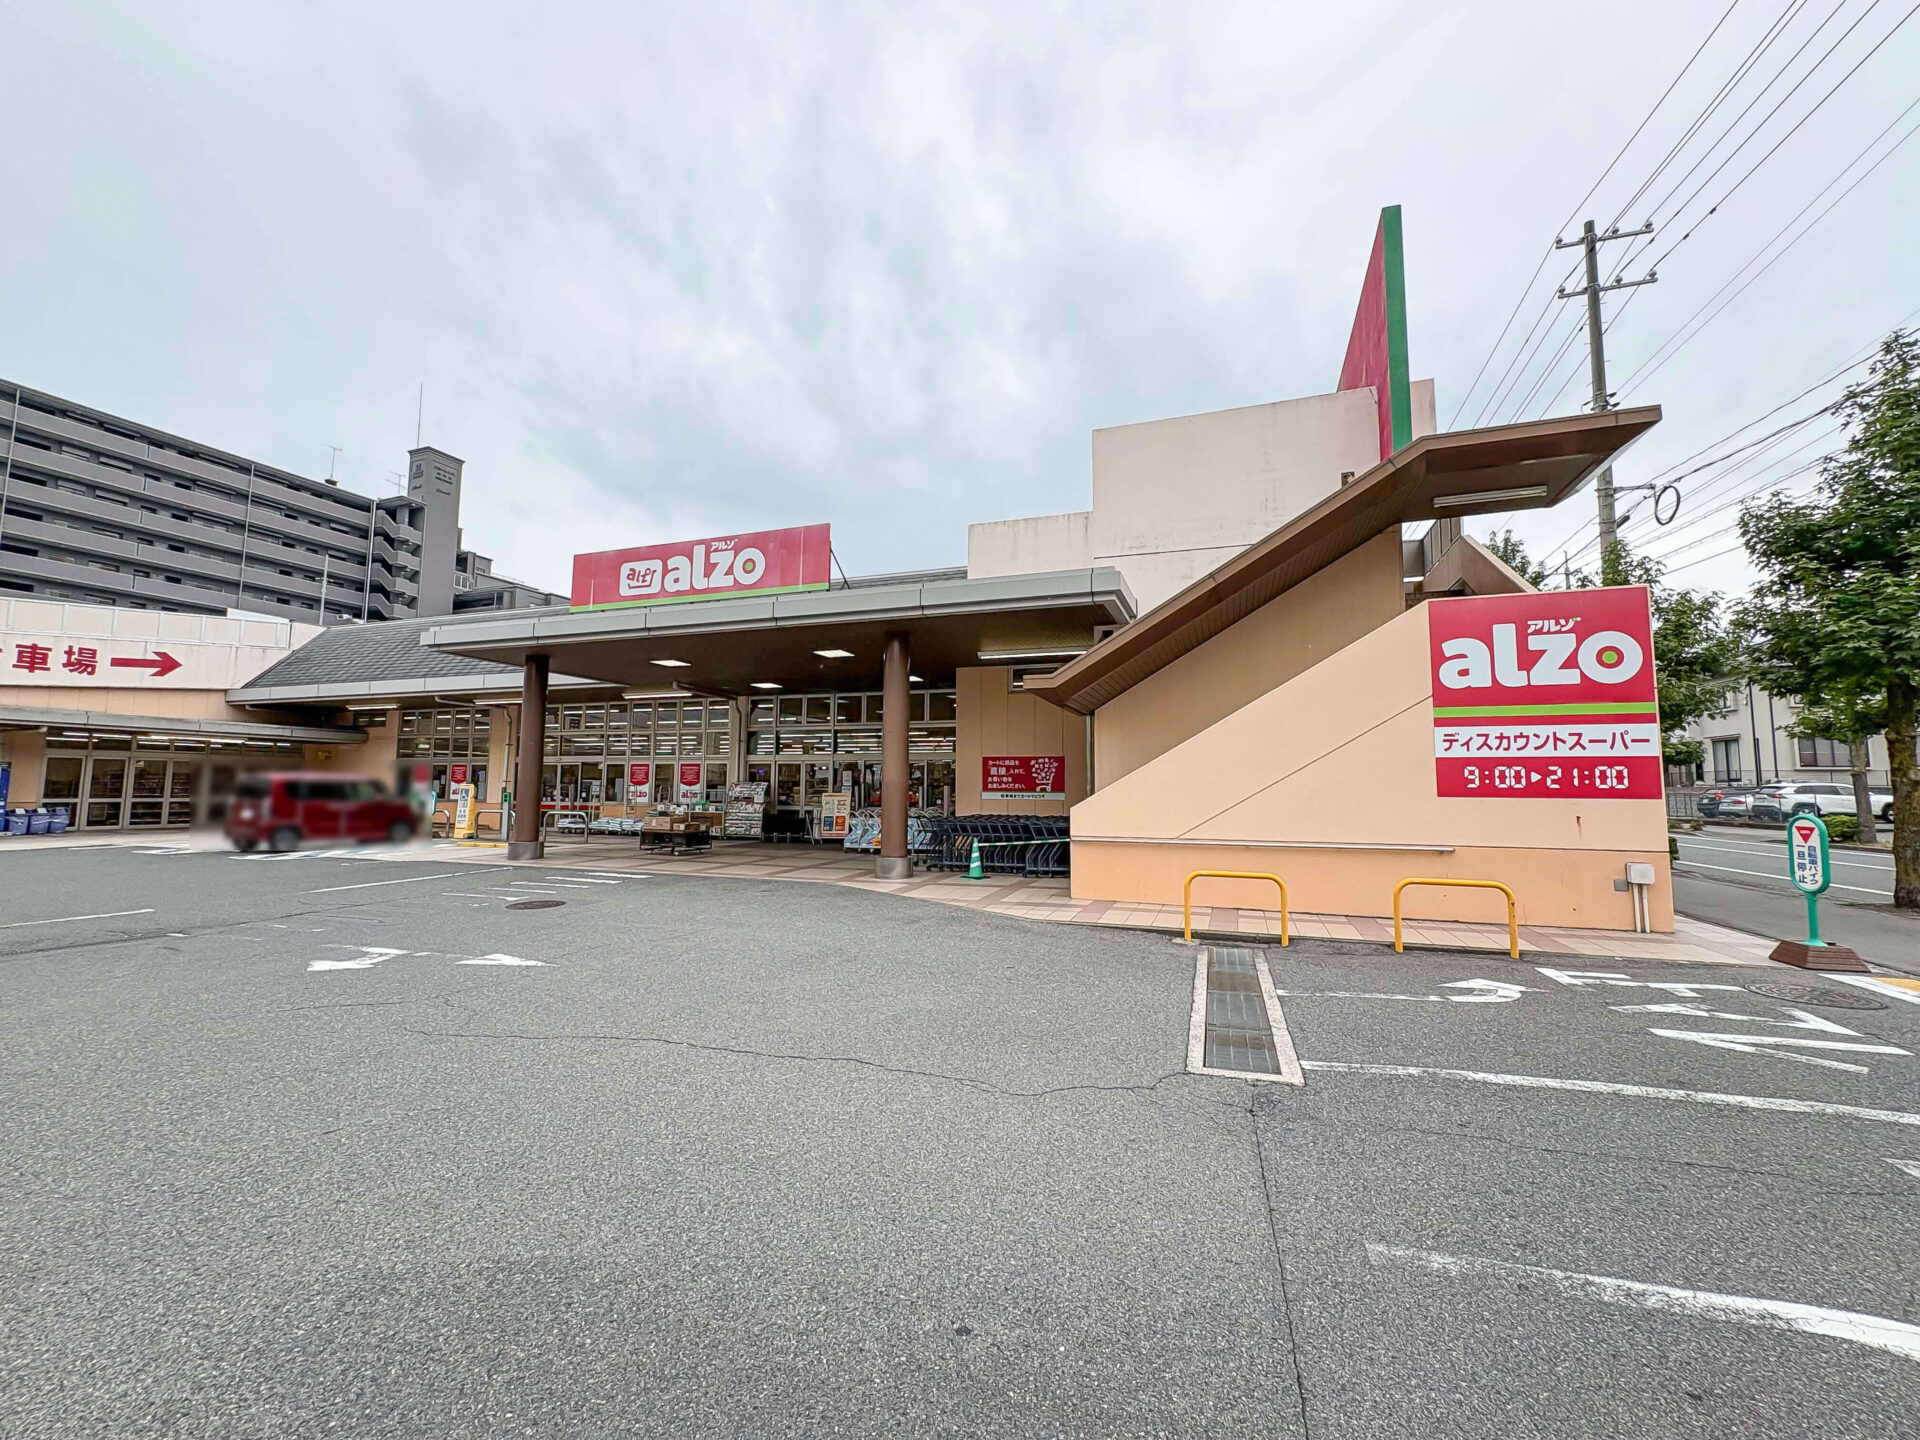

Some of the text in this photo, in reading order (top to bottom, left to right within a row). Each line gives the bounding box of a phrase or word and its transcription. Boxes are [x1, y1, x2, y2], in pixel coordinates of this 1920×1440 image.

[710, 538, 738, 551] アルゾ
[664, 545, 766, 592] alzo
[1527, 617, 1582, 634] アルゾ
[0, 643, 99, 676] 車場
[1438, 622, 1643, 690] alzo
[1442, 731, 1650, 753] ディスカウントスーパー
[1464, 765, 1629, 789] 9:00 21:00
[1795, 844, 1808, 884] 一旦停止
[1807, 845, 1819, 885] 自転車バイク
